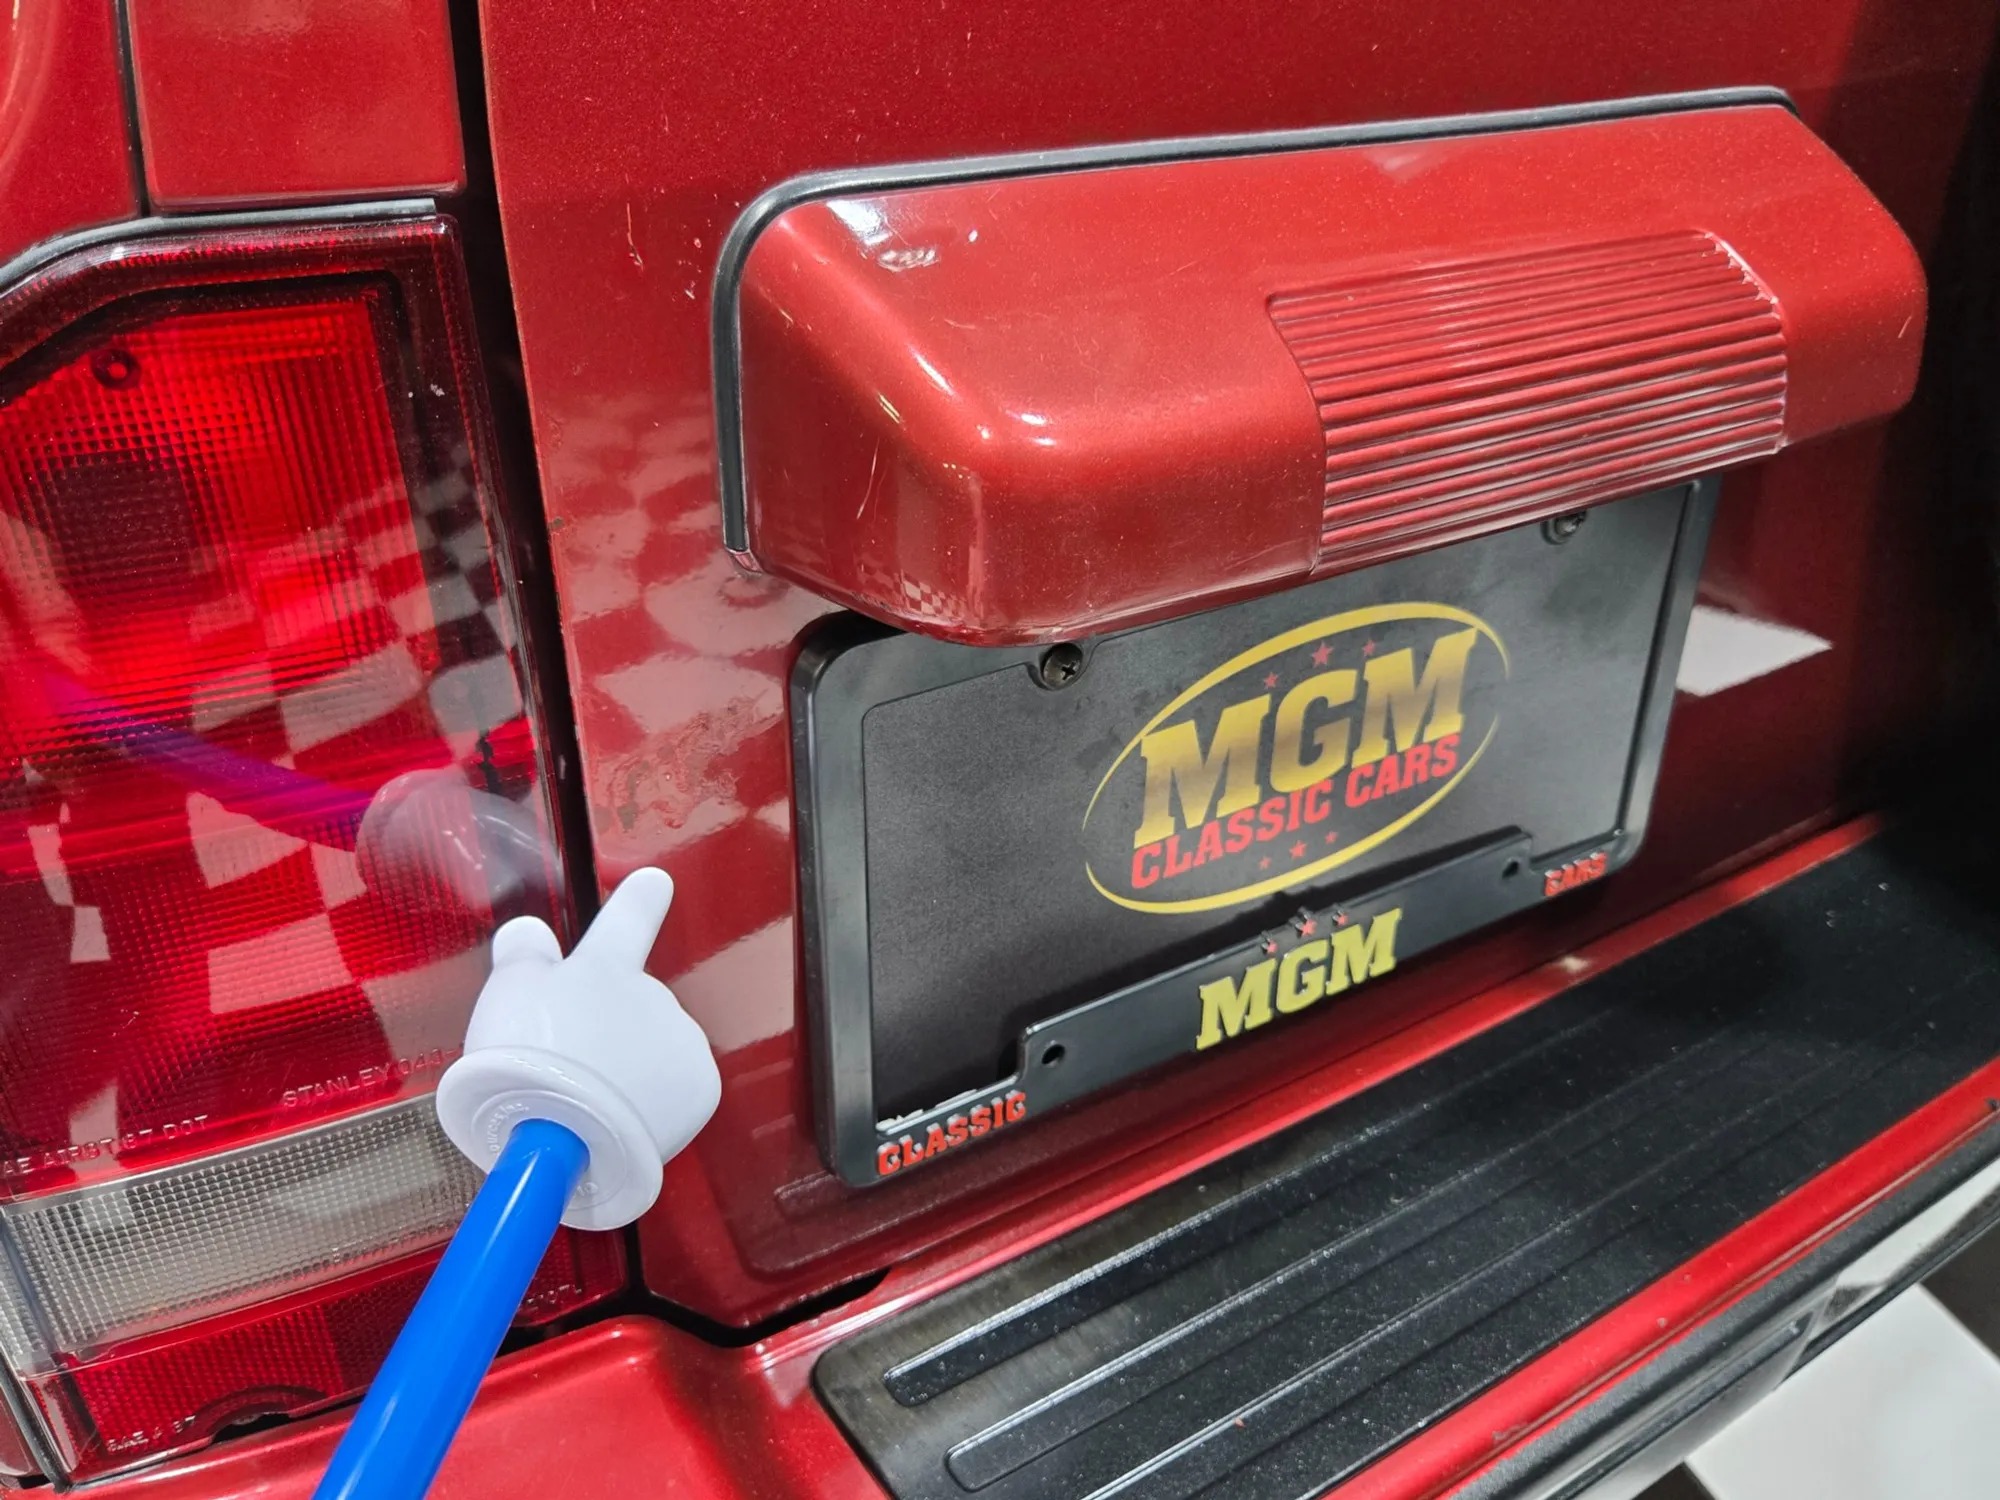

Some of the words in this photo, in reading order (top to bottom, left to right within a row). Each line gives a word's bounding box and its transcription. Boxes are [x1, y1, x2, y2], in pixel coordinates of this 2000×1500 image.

[1134, 628, 1478, 849] MGM
[1131, 778, 1333, 890] CLASSIC
[1344, 732, 1461, 808] CARS
[1544, 852, 1608, 896] CARS
[1195, 908, 1402, 1050] MGM
[282, 1063, 390, 1107] STANLEY
[0, 1156, 35, 1177] AE
[163, 1114, 208, 1140] DOT
[877, 1089, 1027, 1176] CLASSIC
